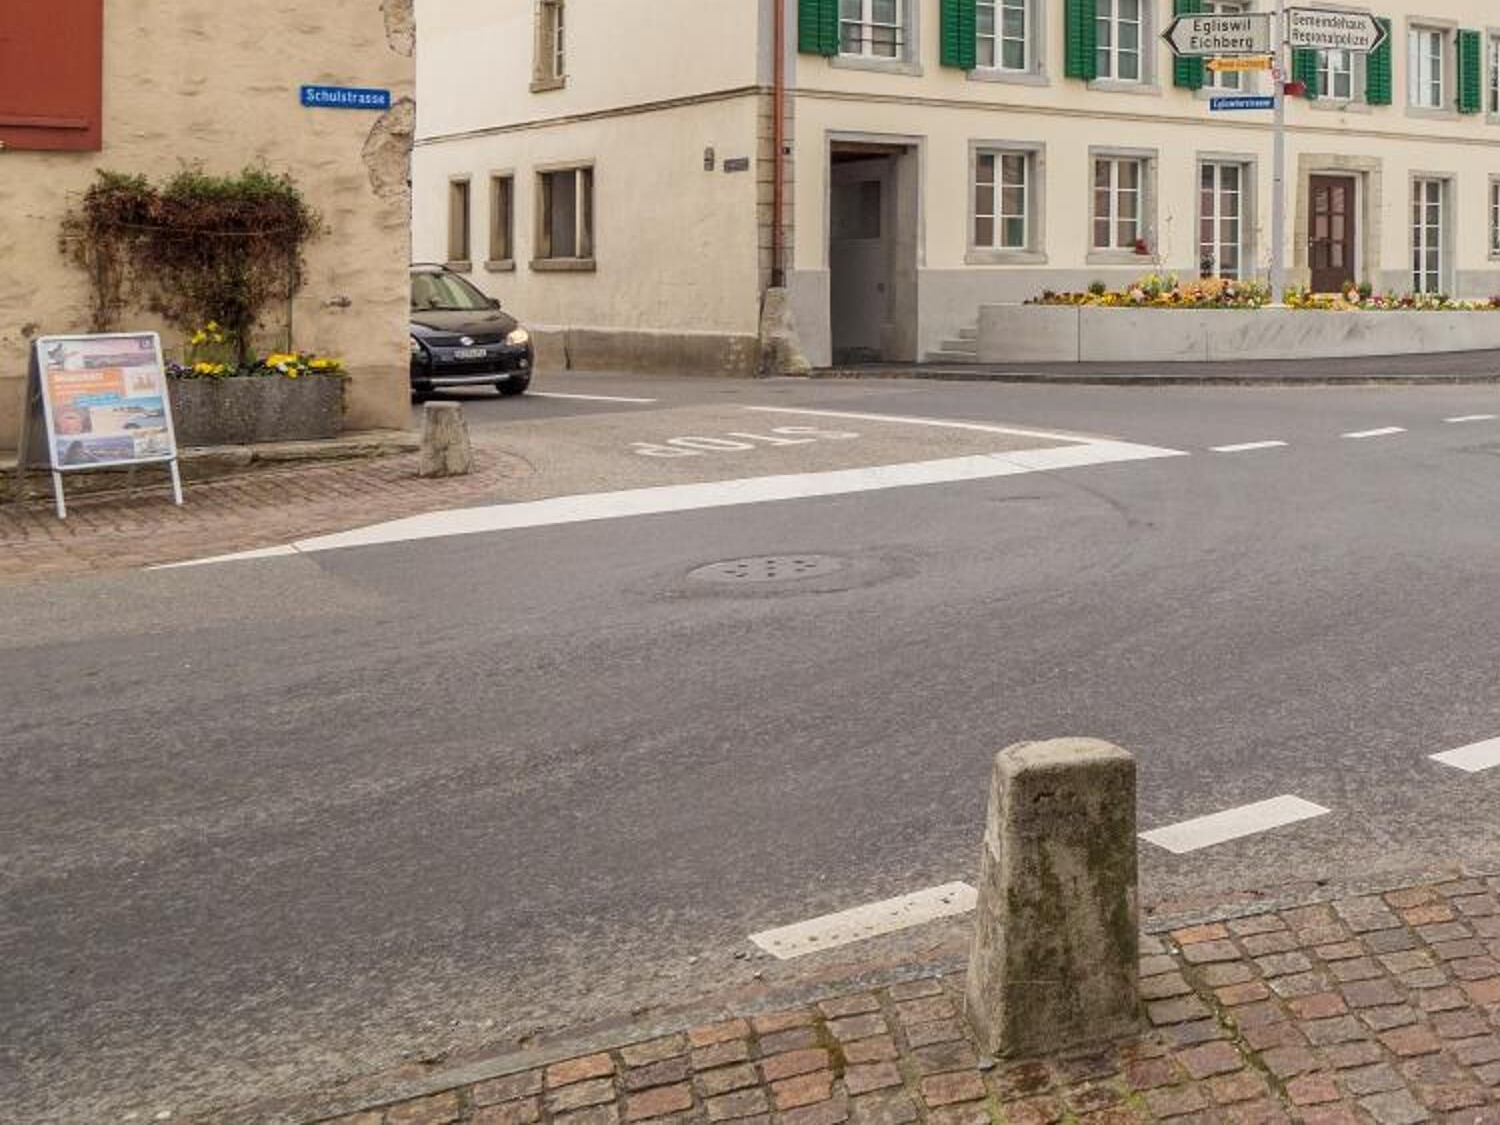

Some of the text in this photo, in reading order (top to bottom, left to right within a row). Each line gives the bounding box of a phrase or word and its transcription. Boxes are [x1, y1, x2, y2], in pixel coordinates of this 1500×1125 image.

[1193, 19, 1251, 35] Egliswil
[1292, 12, 1367, 30] Gemeindehaus
[1190, 36, 1253, 52] Eichberg
[1291, 28, 1369, 47] Regionalpolizei
[306, 88, 385, 104] Schulstrasse
